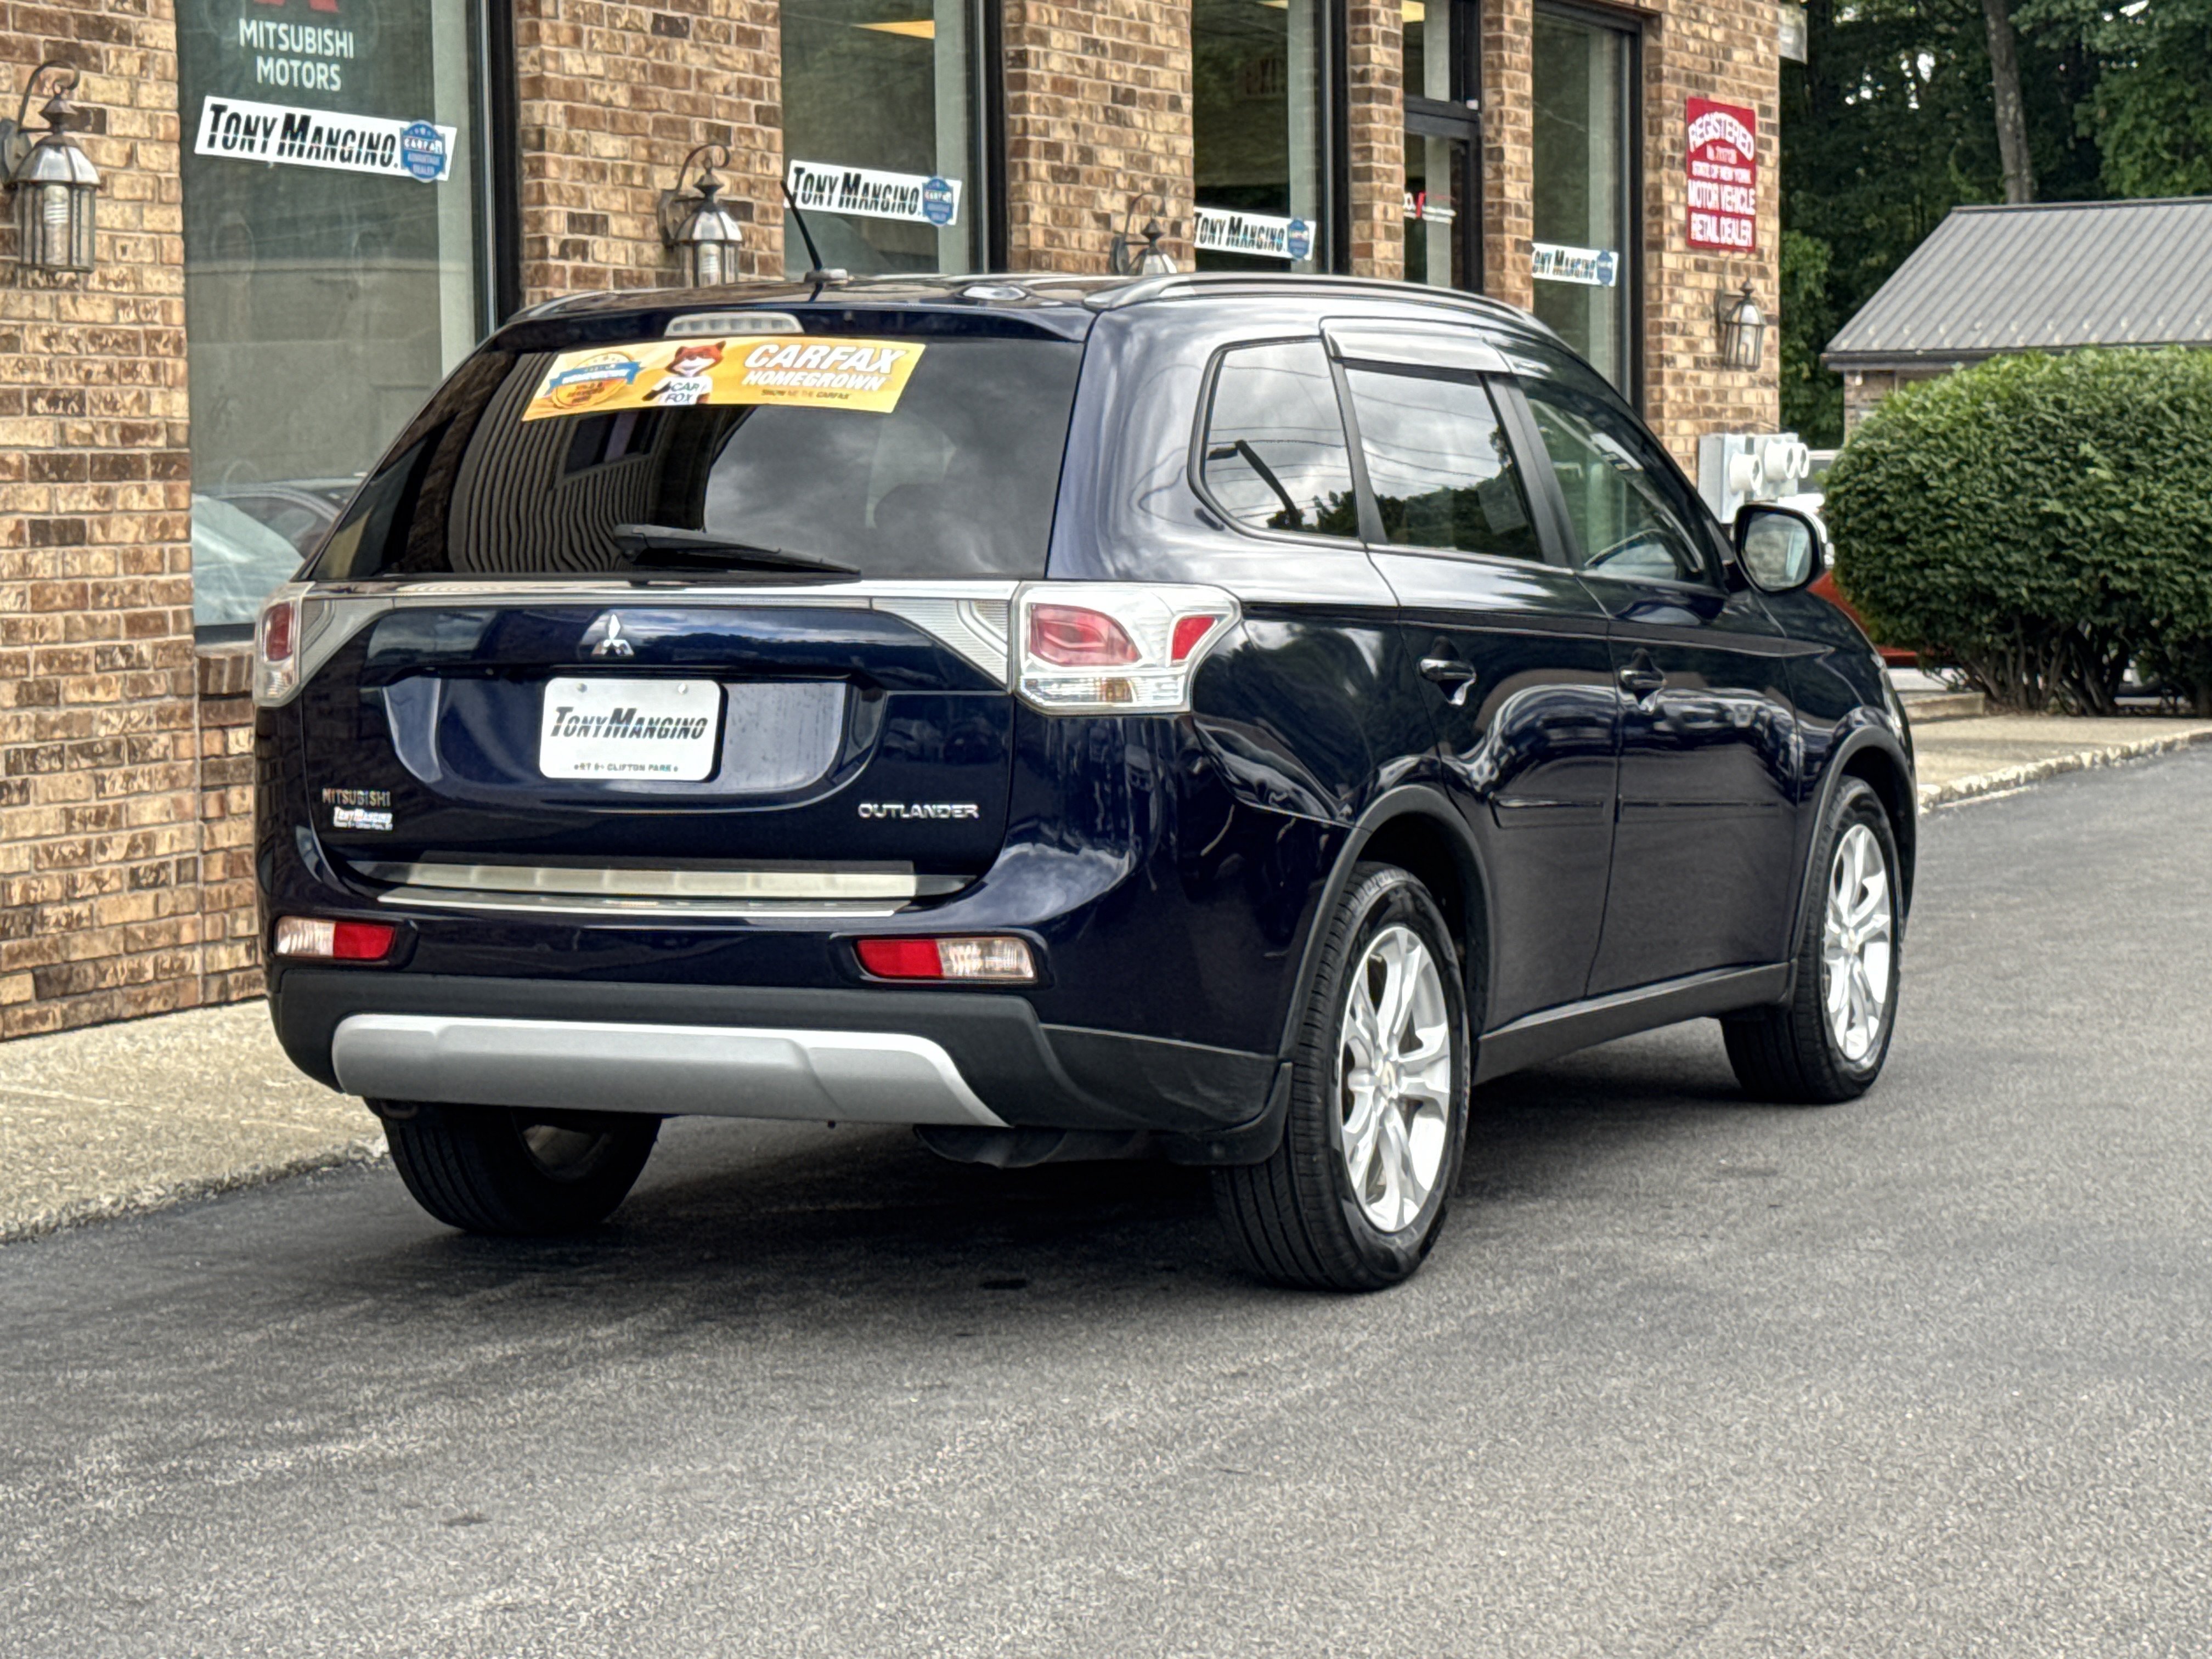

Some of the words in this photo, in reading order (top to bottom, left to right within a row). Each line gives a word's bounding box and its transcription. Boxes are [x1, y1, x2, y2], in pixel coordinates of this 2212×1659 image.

[239, 18, 354, 59] MITSUBISHI
[256, 55, 341, 91] MOTORS
[207, 103, 278, 154] TONY
[1688, 111, 1754, 161] REGISTERED
[793, 167, 839, 207] TONY
[1688, 179, 1719, 211] MOTOR
[1720, 184, 1756, 215] VEHICLE
[744, 343, 907, 374] CARFAX
[671, 382, 700, 392] CAR
[742, 370, 887, 391] HOMEGROWN
[665, 393, 693, 403] FOX
[602, 708, 708, 740] MANGINO
[607, 763, 646, 771] CLIFTON
[648, 764, 672, 772] PARK
[321, 788, 391, 807] MITSUBISHI
[857, 803, 980, 819] OUTLANDER
